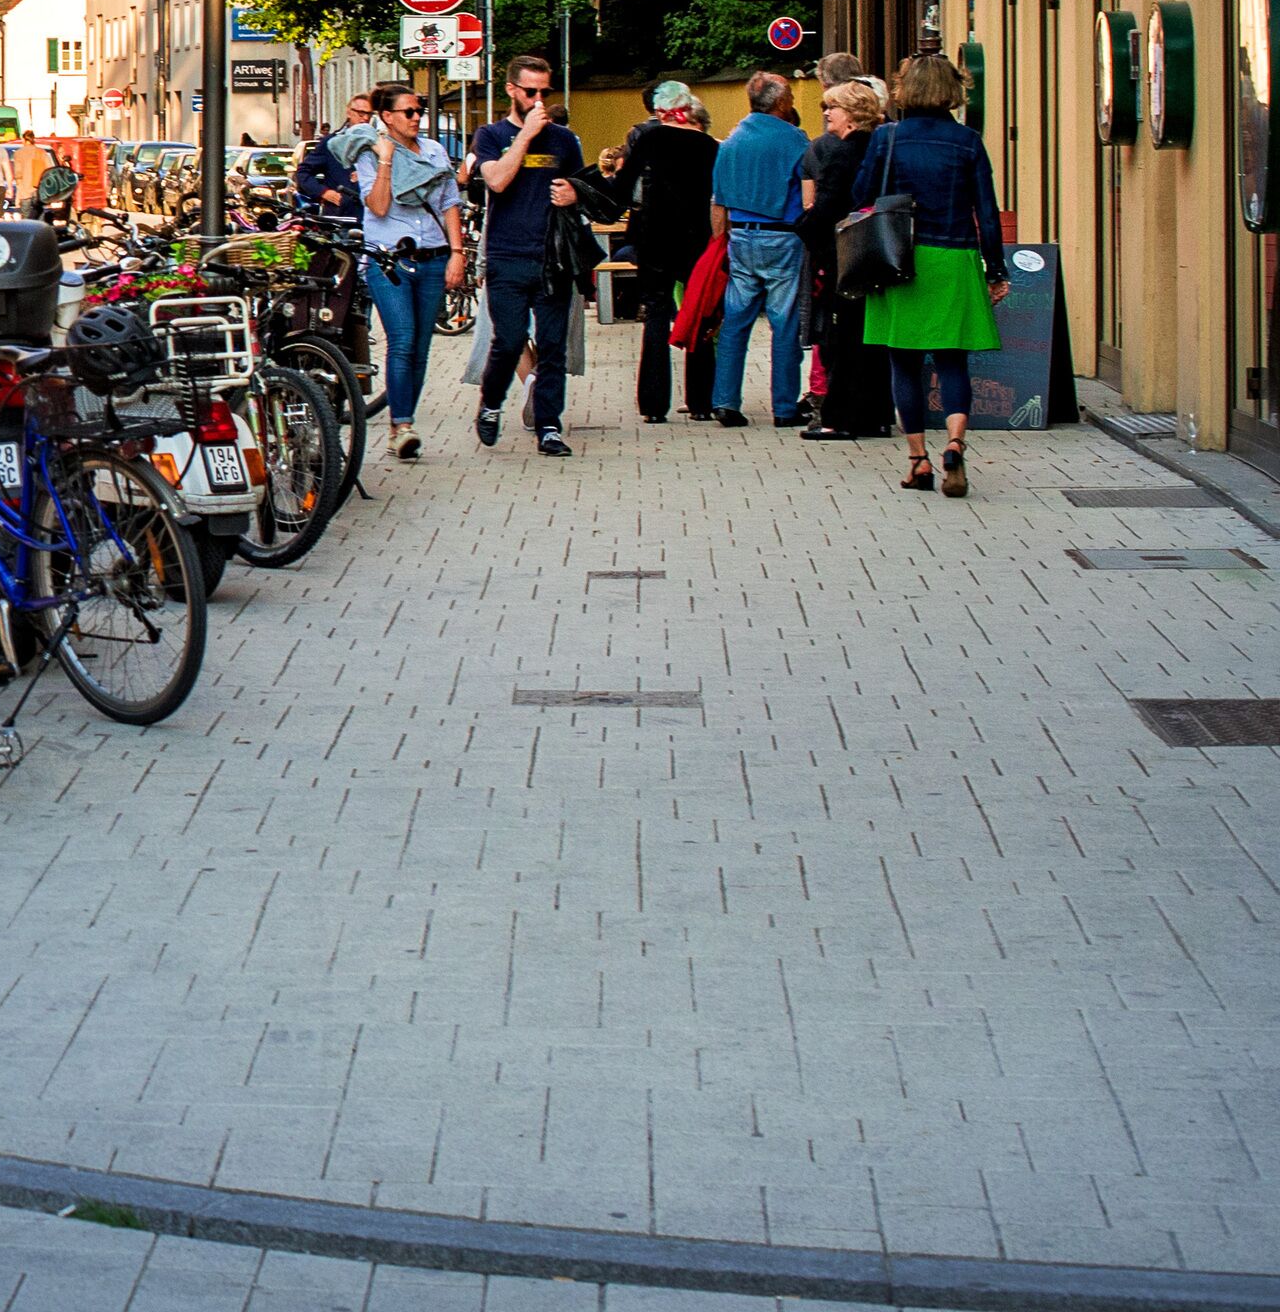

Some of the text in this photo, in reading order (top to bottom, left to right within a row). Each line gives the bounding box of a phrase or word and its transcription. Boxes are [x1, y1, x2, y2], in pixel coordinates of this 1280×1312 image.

[233, 65, 284, 77] ARTwegr
[209, 447, 235, 463] 194
[215, 466, 240, 481] AFG
